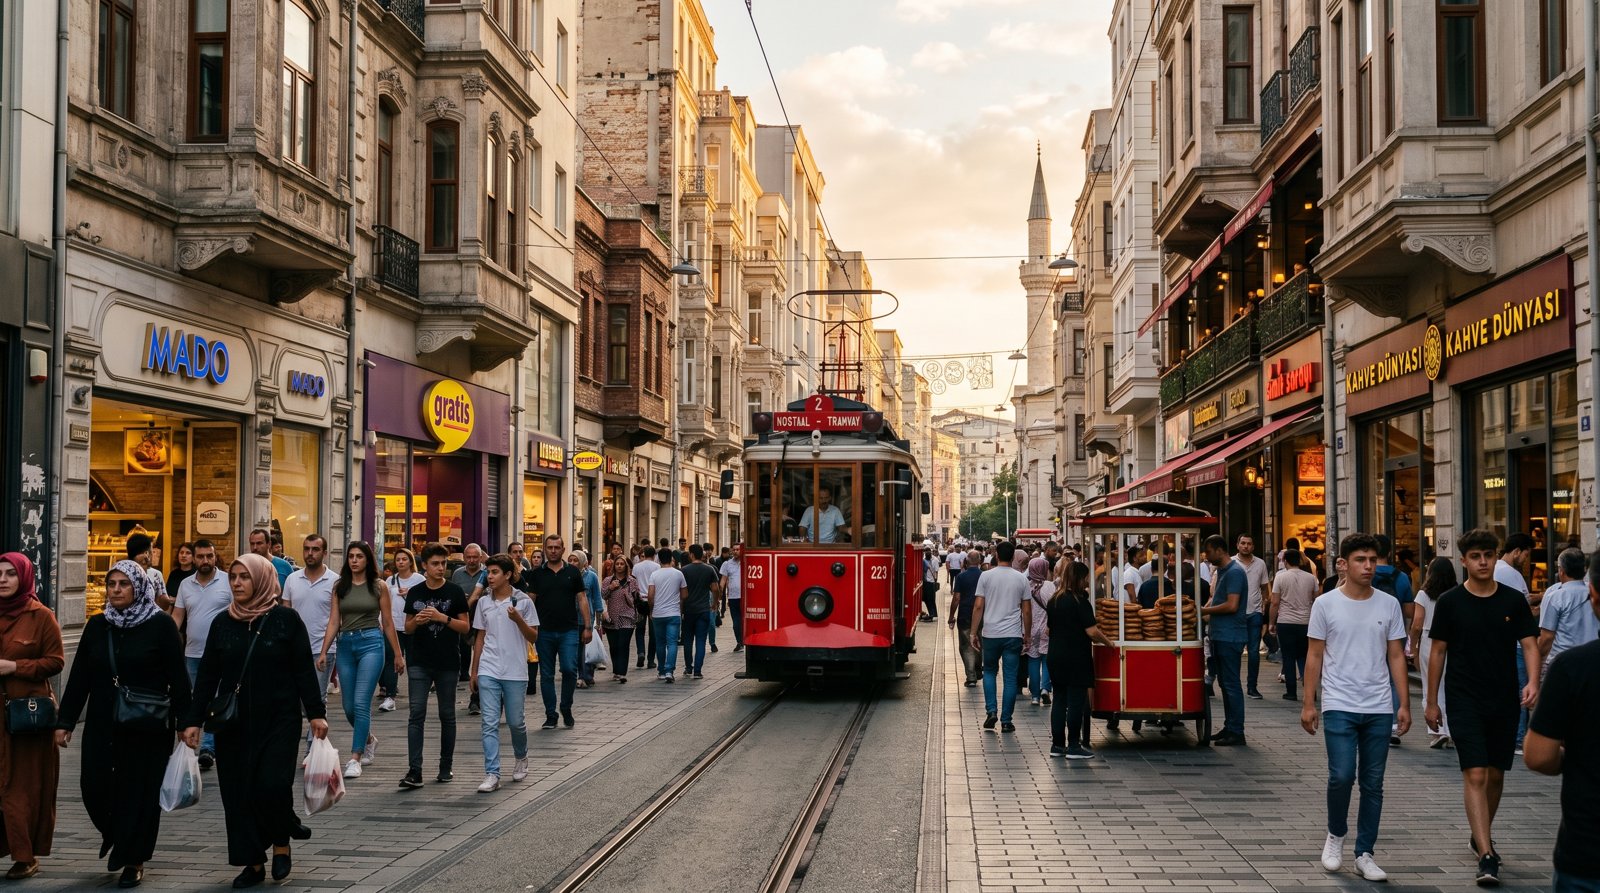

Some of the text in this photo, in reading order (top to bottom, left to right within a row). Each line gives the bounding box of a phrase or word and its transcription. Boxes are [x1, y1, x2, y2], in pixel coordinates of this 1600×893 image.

[1446, 318, 1488, 358] KAHVE
[1493, 288, 1560, 340] DÜNYASI
[146, 323, 230, 385] MADO
[1346, 367, 1375, 395] KAHVE
[1378, 345, 1422, 382] DÜNYASI
[290, 370, 325, 397] MADO
[434, 394, 470, 425] gratis
[815, 398, 822, 411] 2
[776, 416, 810, 427] NOSTAAL
[827, 416, 861, 426] TRAMVAY
[575, 455, 599, 464] gratis
[747, 565, 763, 579] 223
[870, 565, 887, 579] 223
